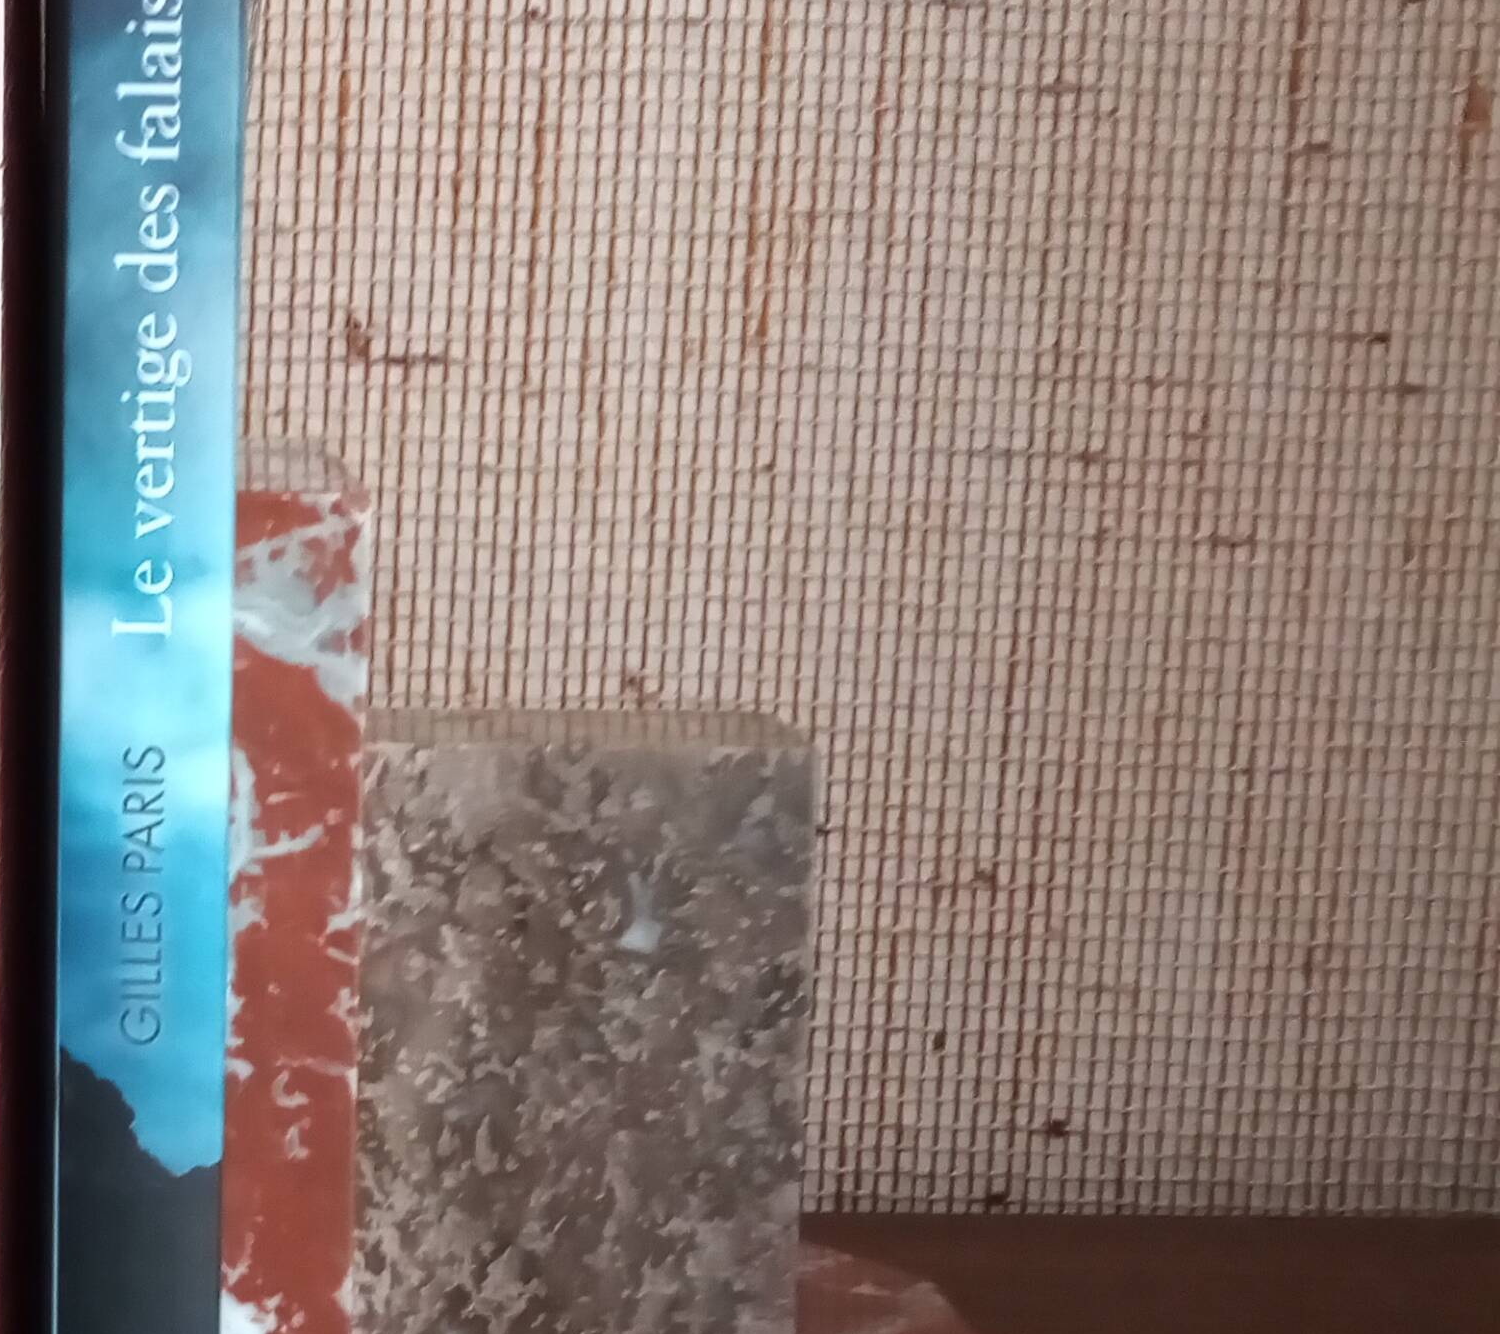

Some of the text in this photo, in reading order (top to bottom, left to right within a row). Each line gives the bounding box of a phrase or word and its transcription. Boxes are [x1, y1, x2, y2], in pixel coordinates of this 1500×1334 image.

[113, 182, 180, 293] des
[121, 309, 192, 540] vertige
[111, 556, 175, 638] Le
[119, 744, 167, 1046] GILLES PARIS
